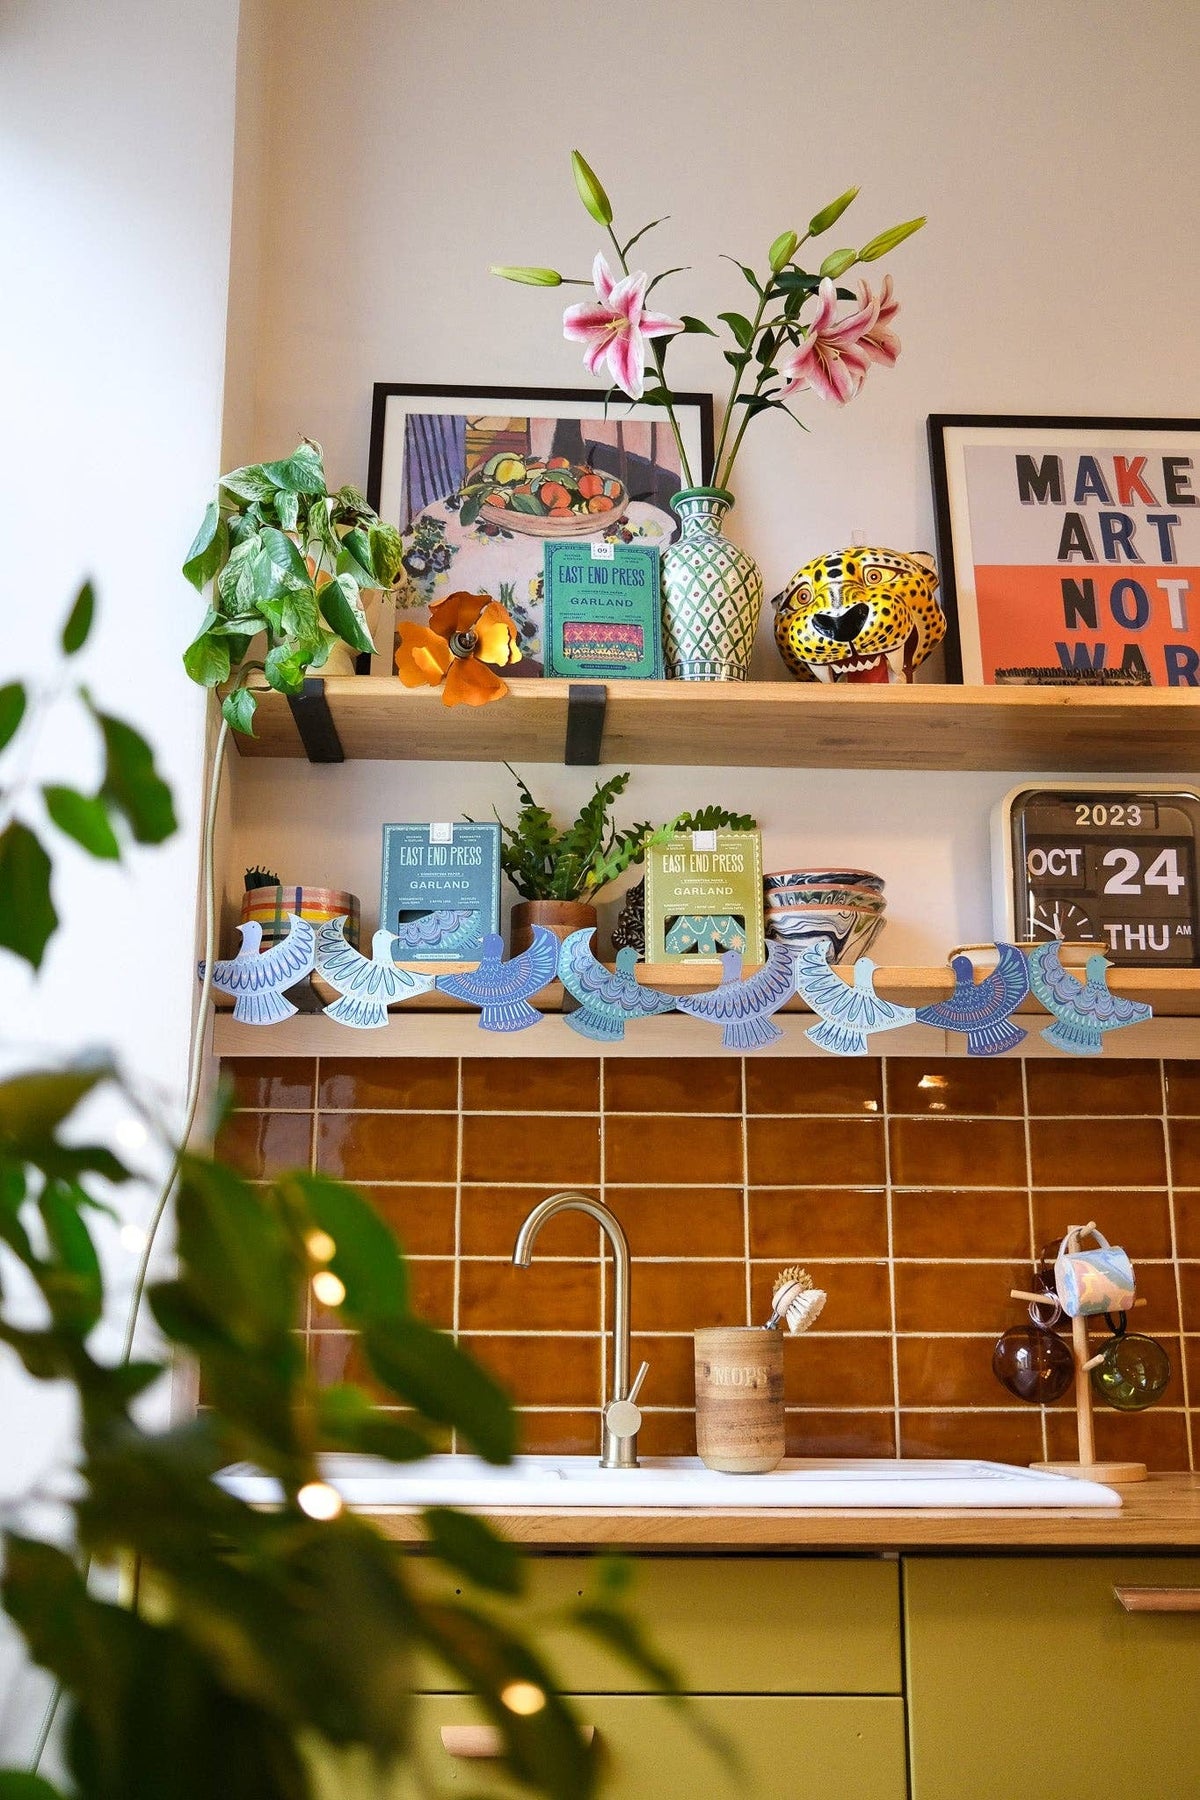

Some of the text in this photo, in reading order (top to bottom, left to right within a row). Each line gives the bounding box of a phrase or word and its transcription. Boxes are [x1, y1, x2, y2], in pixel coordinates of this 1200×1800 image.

[1015, 454, 1200, 508] MAKE
[1057, 511, 1182, 564] ART
[559, 565, 645, 587] EAST END PRESS
[570, 597, 633, 607] GARLAND
[1061, 578, 1191, 632] NOT
[1075, 804, 1142, 827] 2023
[400, 846, 482, 866] EAST END PRESS
[662, 854, 744, 873] EAST END PRESS
[1027, 848, 1185, 895] OCT 24
[410, 880, 470, 889] GARLAND
[674, 887, 734, 896] GARLAND
[1103, 924, 1192, 951] THU AM
